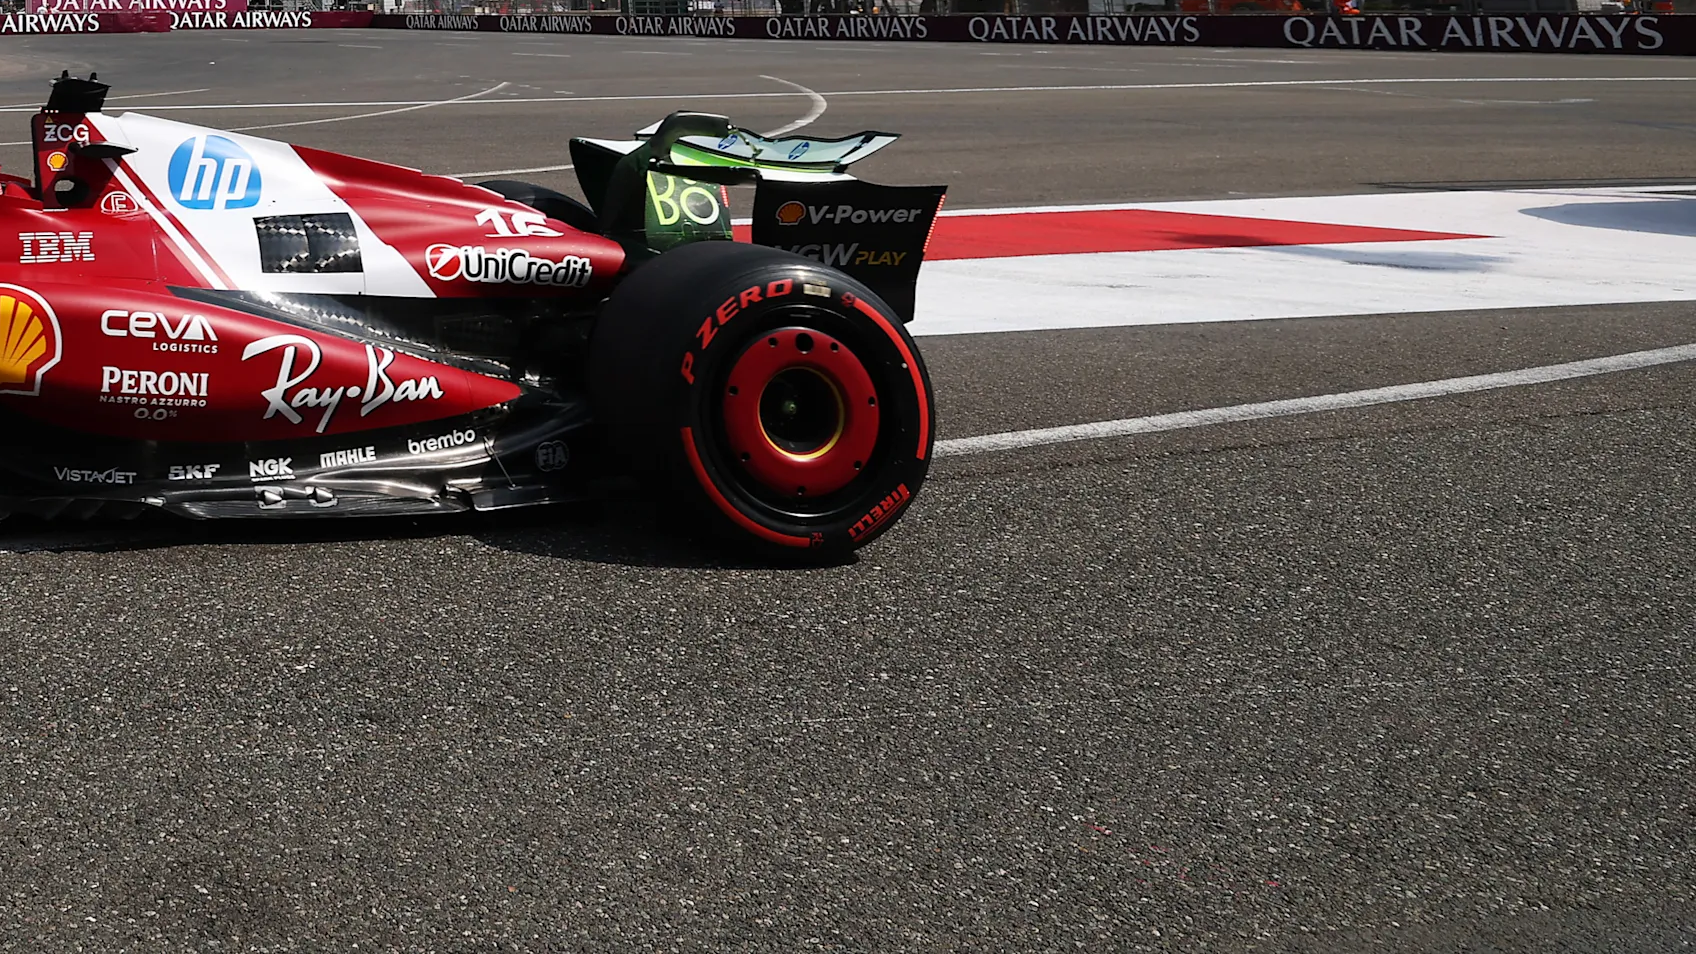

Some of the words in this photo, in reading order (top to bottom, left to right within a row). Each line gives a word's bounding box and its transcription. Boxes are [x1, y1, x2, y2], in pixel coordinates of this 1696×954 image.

[1, 13, 100, 33] AIRWAYS
[232, 11, 312, 28] AIRWAYS
[406, 15, 436, 29] QATAR
[437, 15, 478, 30] AIRWAYS
[500, 16, 537, 32] QATAR
[540, 16, 592, 33] AIRWAYS
[615, 16, 664, 35] QATAR
[667, 16, 736, 36] AIRWAYS
[766, 16, 831, 39] QATAR
[836, 16, 928, 39] AIRWAYS
[968, 16, 1056, 42] QATAR
[1066, 16, 1200, 44] AIRWAYS
[1283, 16, 1423, 46] QATAR
[1440, 16, 1665, 50] AIRWAYS
[179, 135, 254, 210] hp
[475, 207, 564, 238] 16
[808, 204, 922, 225] V-Power
[19, 231, 95, 263] IBM
[855, 250, 907, 266] PLAY
[461, 246, 593, 288] UniCredit
[680, 351, 695, 385] P
[695, 278, 794, 350] ZERO
[152, 342, 218, 354] LOGISTICS
[100, 366, 210, 397] PERONI
[99, 395, 148, 406] NASTRO
[150, 397, 207, 408] AZZURRO
[134, 407, 178, 420] 0.0%
[407, 428, 476, 456] brembo
[248, 456, 294, 477] NGK
[320, 446, 376, 469] MAHLE
[168, 463, 221, 481] SKF
[847, 482, 910, 543] PIRELLI
